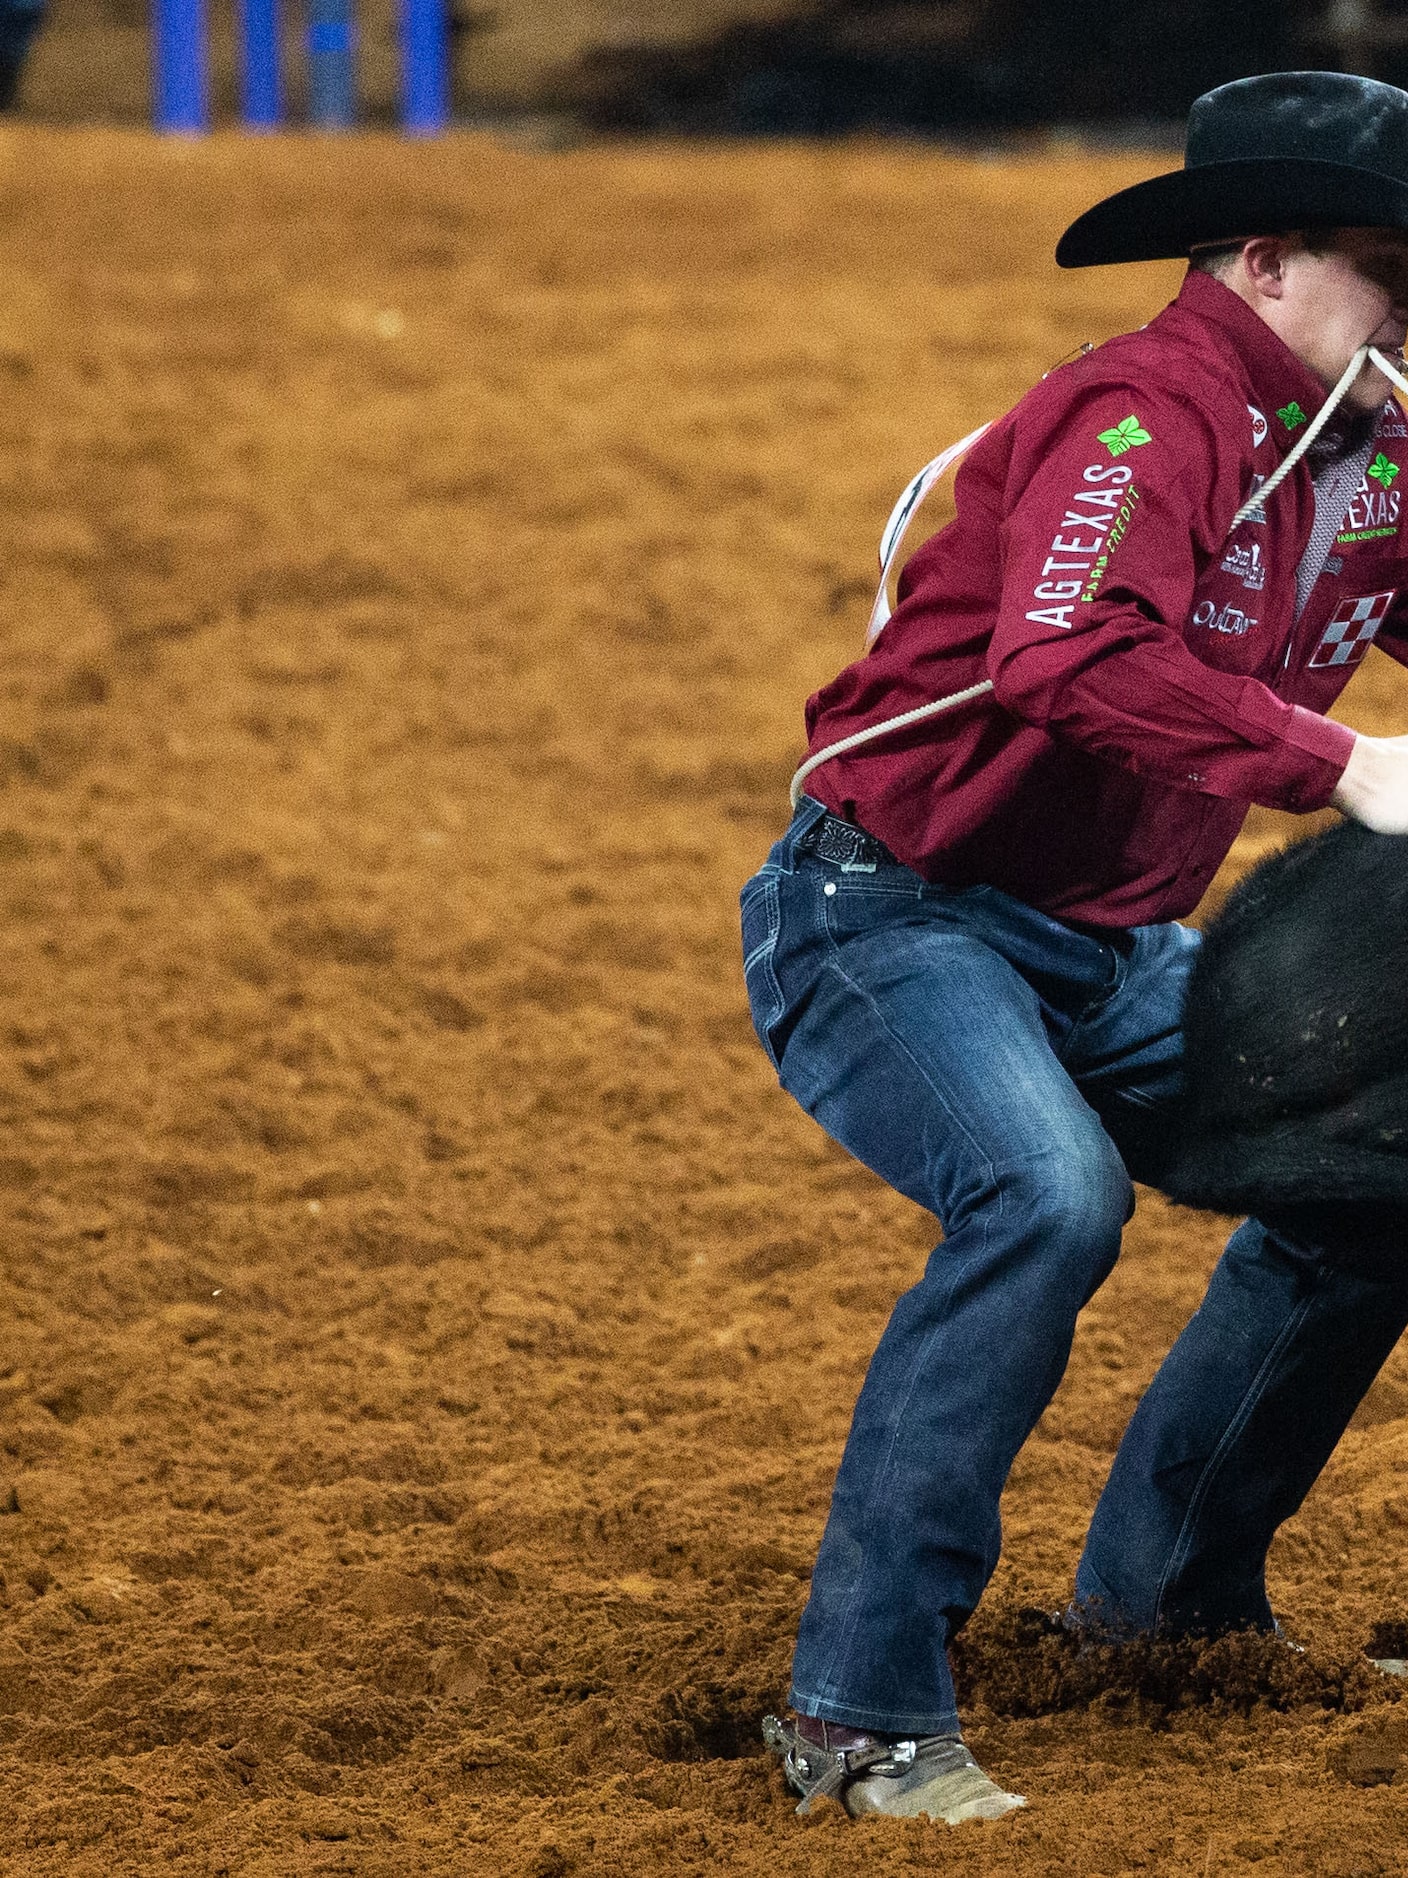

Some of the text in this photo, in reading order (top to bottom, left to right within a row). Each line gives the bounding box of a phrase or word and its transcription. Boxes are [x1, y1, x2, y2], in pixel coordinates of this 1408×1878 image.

[1025, 464, 1133, 629] AGTEXAS
[1081, 485, 1141, 602] FARM CREDIT
[1339, 490, 1401, 531] EXAS
